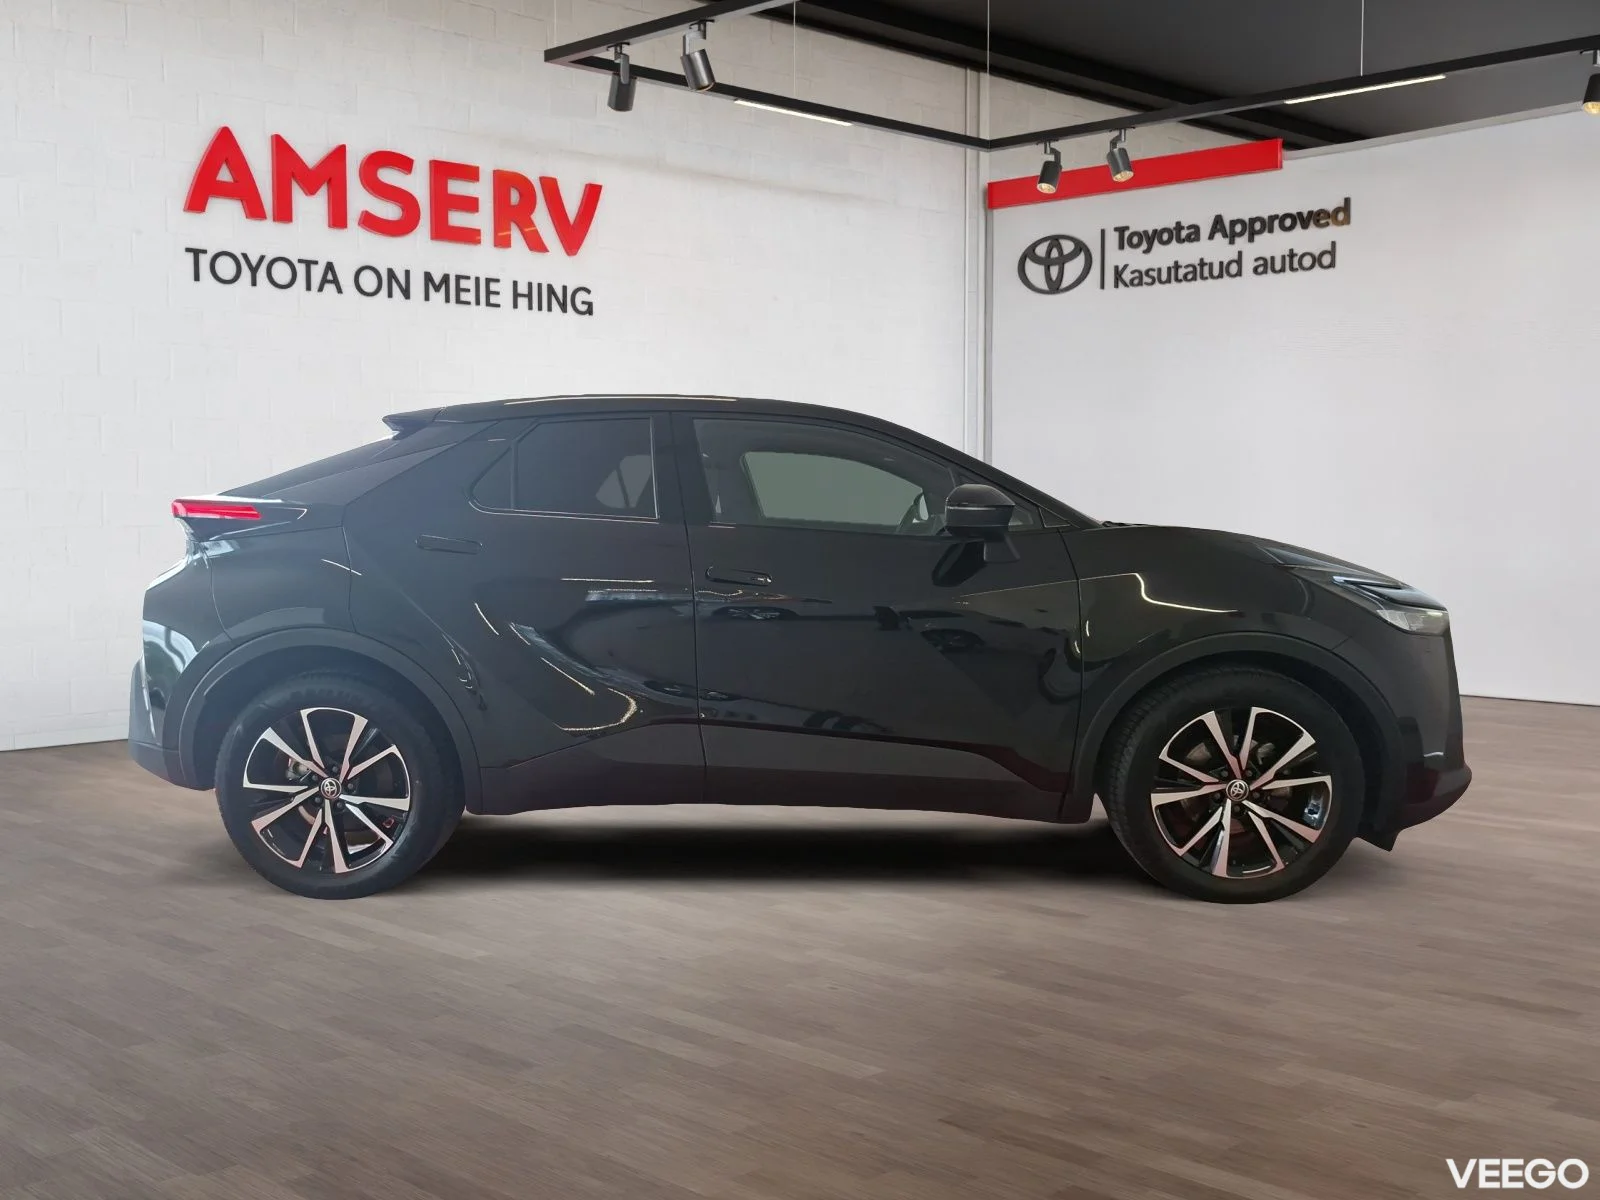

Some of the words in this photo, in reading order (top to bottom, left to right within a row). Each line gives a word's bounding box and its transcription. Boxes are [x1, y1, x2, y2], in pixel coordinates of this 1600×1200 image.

[183, 126, 603, 256] AMSERV
[1113, 221, 1201, 254] Toyota
[1208, 197, 1351, 243] Approved
[185, 247, 343, 294] TOYOTA
[354, 264, 411, 300] ON
[423, 271, 501, 308] MEIE
[512, 280, 594, 316] HING
[1113, 251, 1243, 289] Kasutatud
[1252, 241, 1337, 276] autod
